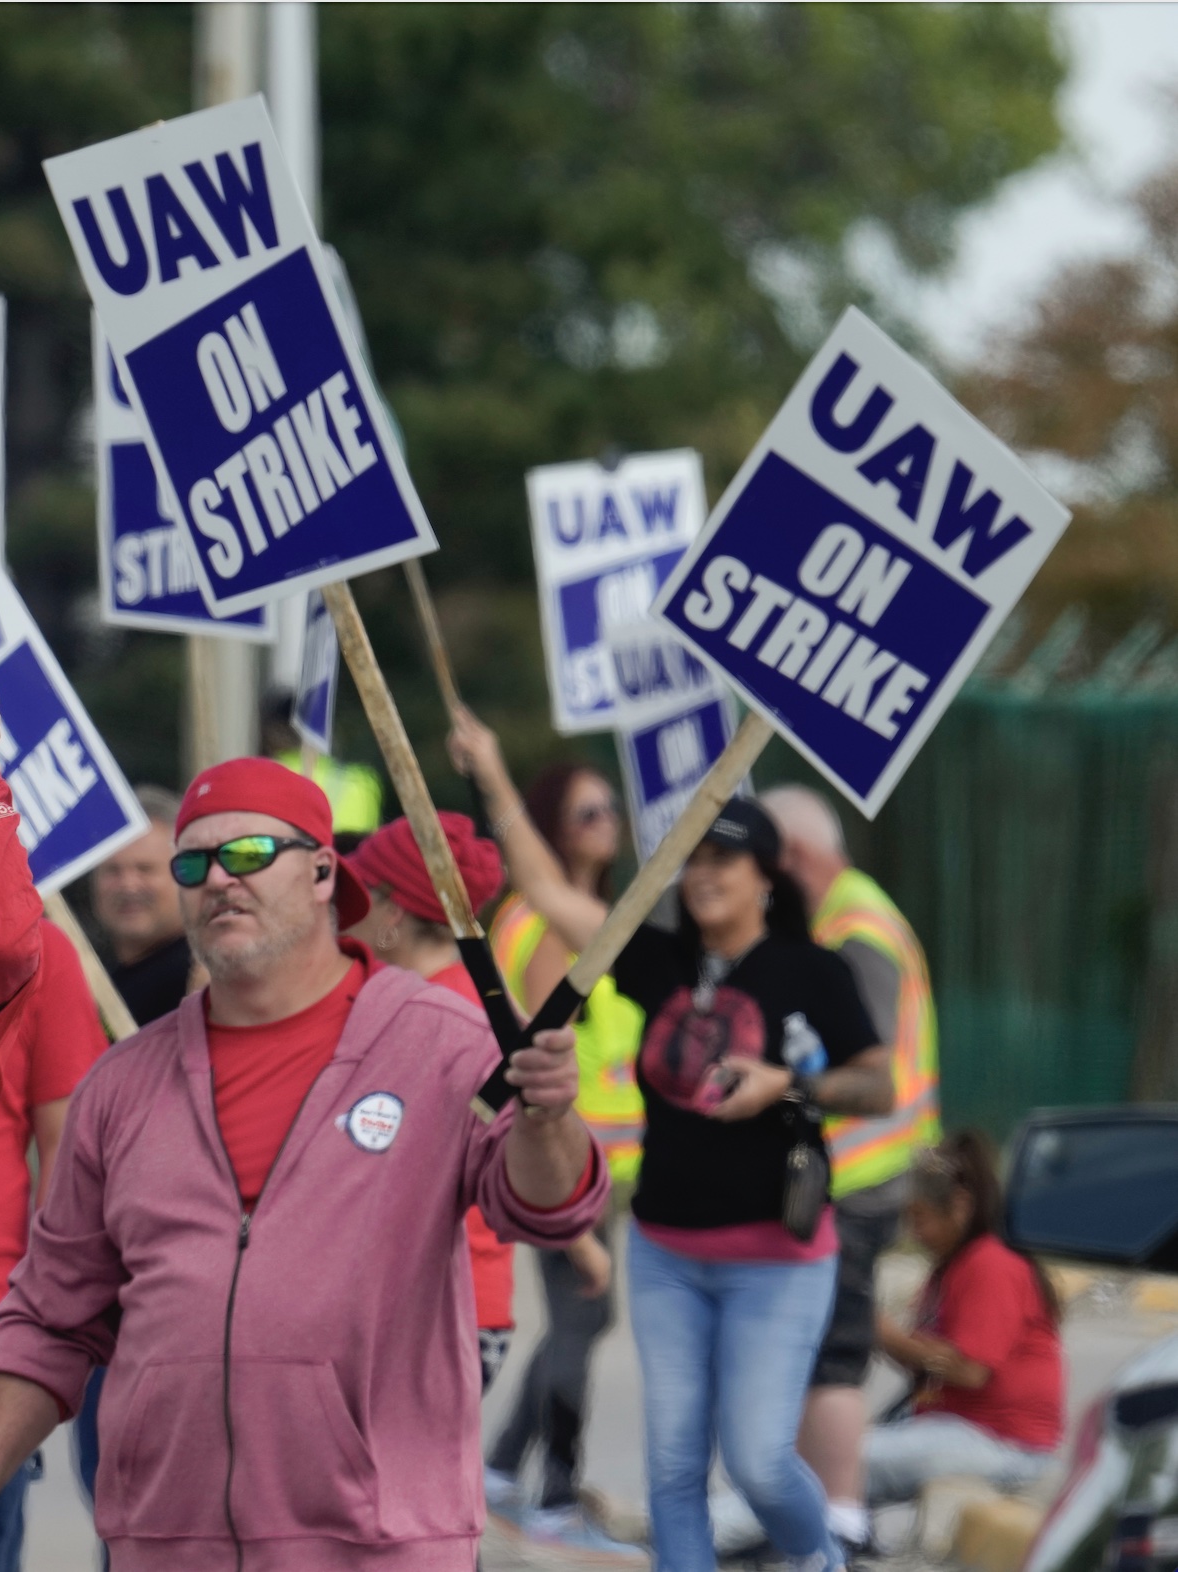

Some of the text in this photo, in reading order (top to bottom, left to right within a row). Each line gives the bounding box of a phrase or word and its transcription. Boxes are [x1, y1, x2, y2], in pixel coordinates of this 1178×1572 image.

[72, 142, 280, 295] UAW
[196, 301, 287, 434] ON
[188, 370, 378, 578] STRIKE
[548, 484, 680, 547] UAW
[809, 352, 1034, 579] UAW
[115, 527, 199, 606] STR
[798, 523, 913, 628] ON
[683, 554, 930, 740] STRIKE
